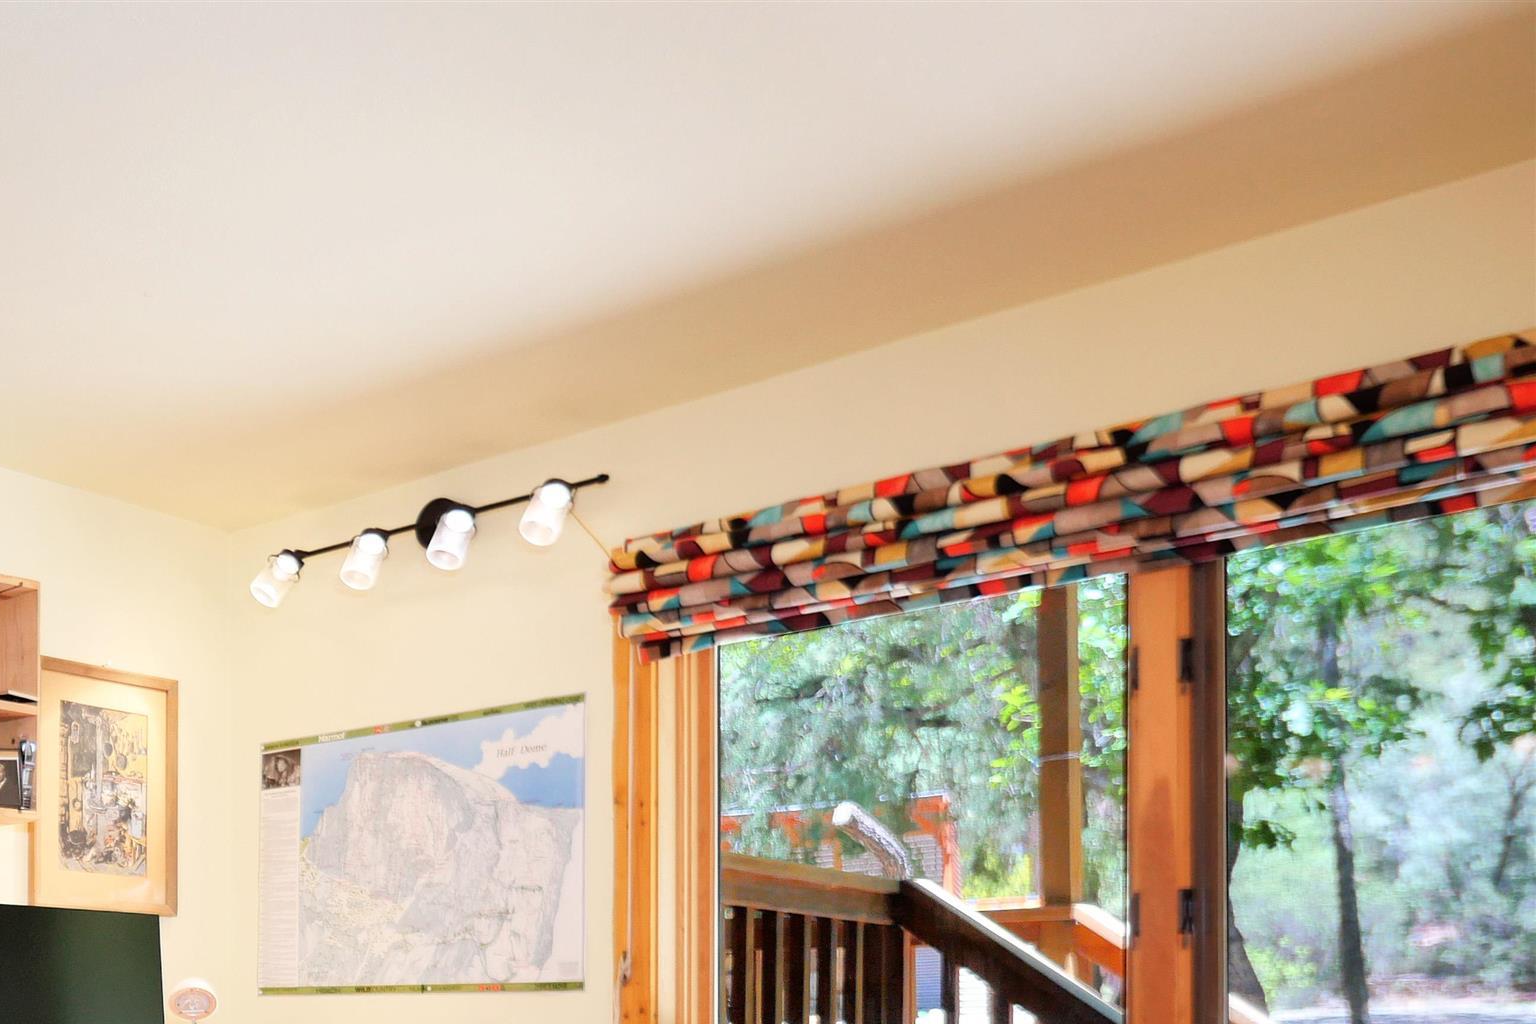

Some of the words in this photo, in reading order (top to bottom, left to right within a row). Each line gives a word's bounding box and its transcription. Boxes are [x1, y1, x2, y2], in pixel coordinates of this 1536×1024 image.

[318, 732, 345, 743] Marmot
[496, 749, 514, 759] Half
[520, 744, 547, 754] Dome
